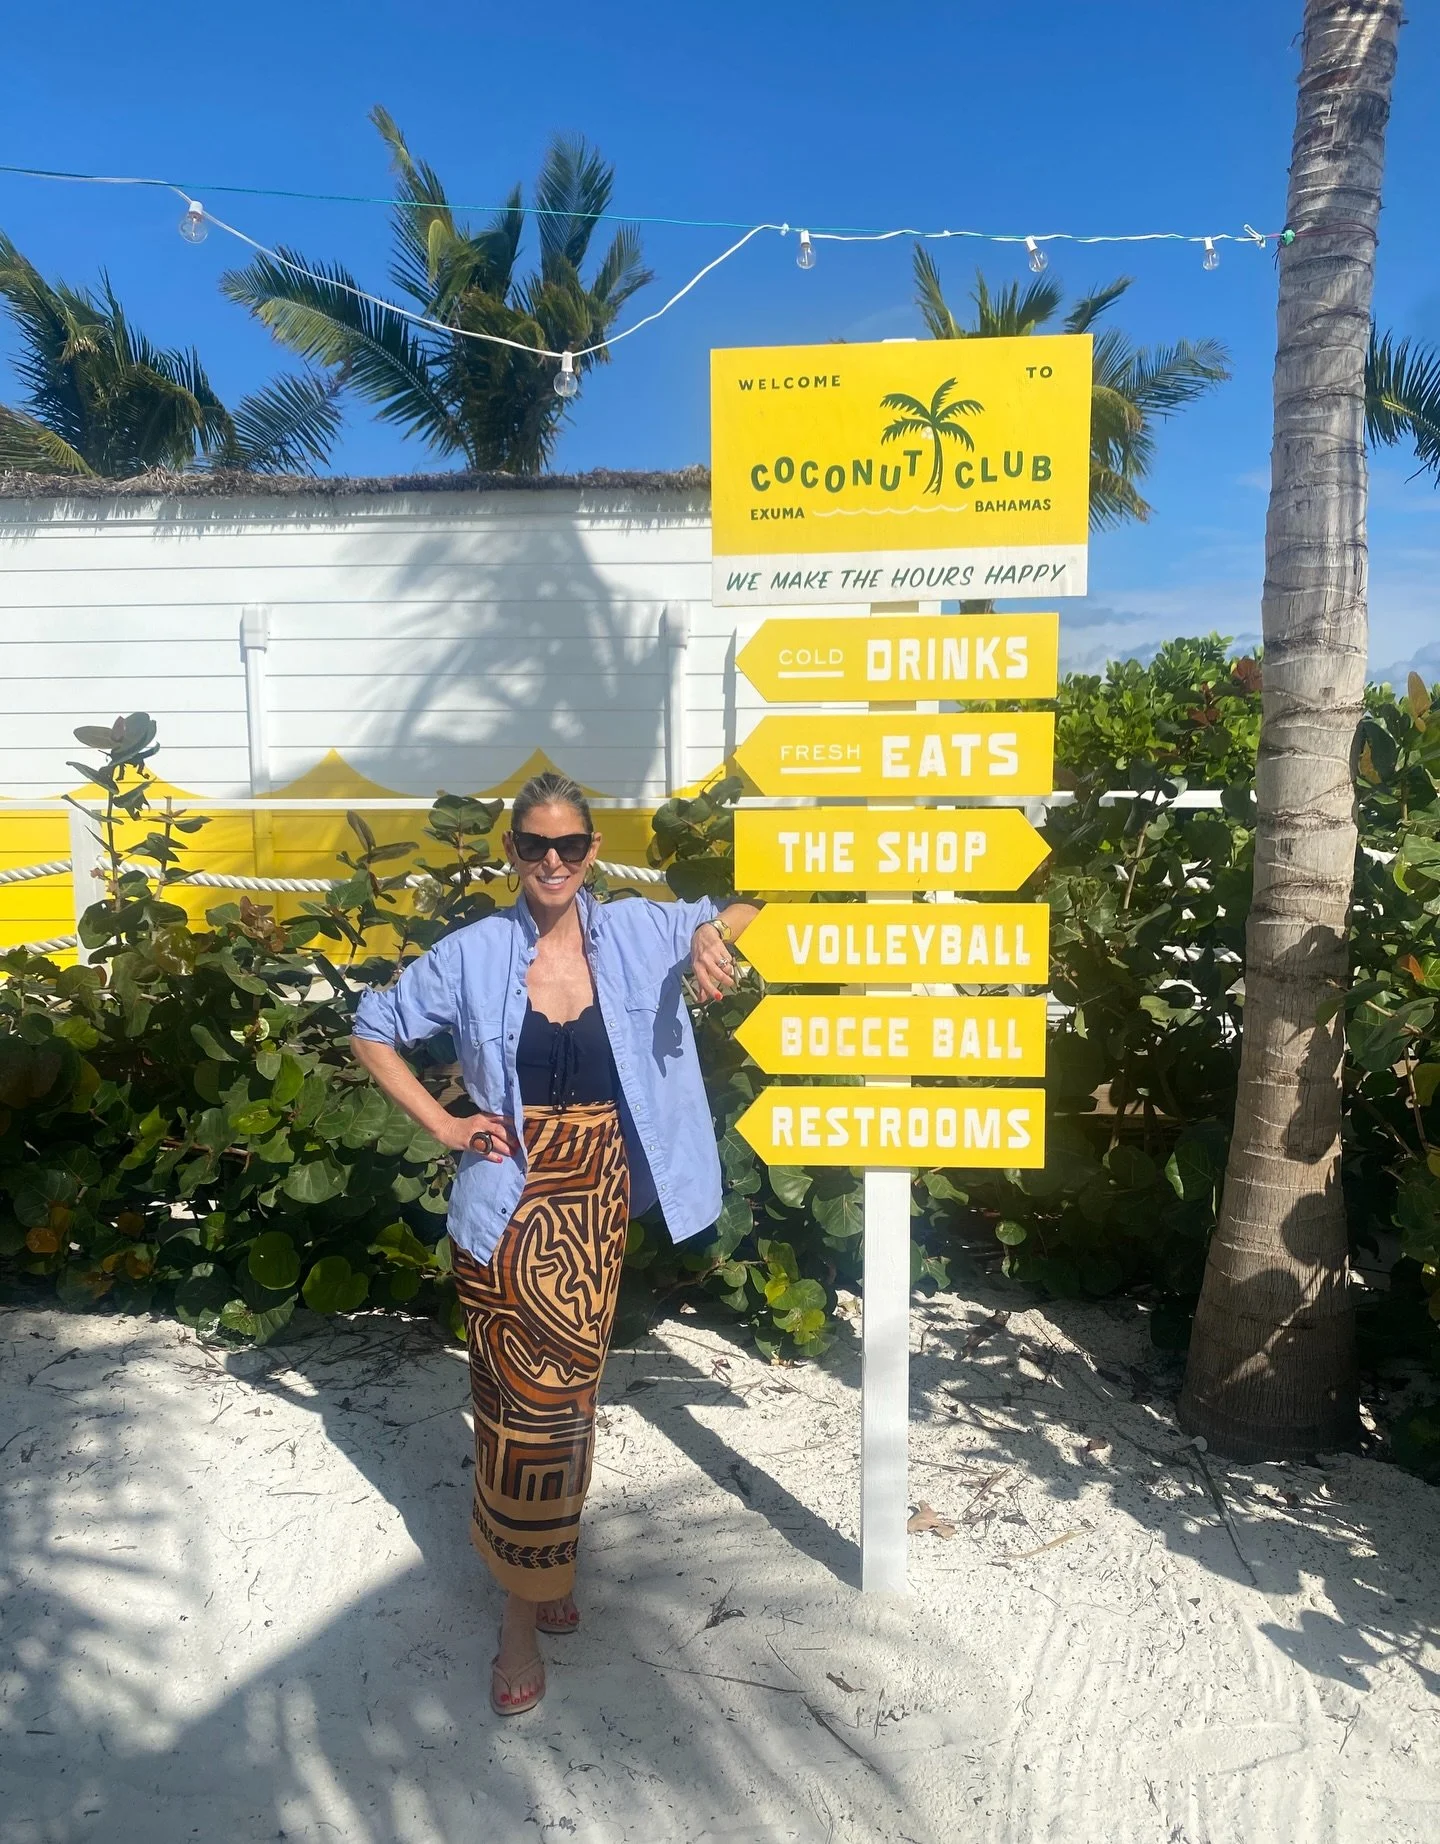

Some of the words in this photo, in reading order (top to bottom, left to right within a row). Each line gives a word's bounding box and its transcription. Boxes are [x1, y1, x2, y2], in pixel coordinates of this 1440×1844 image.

[738, 374, 842, 391] WELCOME
[1026, 366, 1053, 379] TO
[750, 450, 923, 493] COCONUT
[955, 451, 1053, 489] CLUB
[750, 507, 805, 521] EXUMA
[975, 498, 1052, 513] BAHAMAS
[726, 571, 761, 591] WE
[770, 569, 832, 590] MAKE
[841, 568, 884, 588] THE
[891, 566, 974, 588] HOURS
[984, 564, 1066, 584] HAPPY
[778, 648, 844, 665] COLD
[867, 636, 1029, 681] DRINKS
[780, 744, 861, 761] FRESH
[882, 733, 1018, 778] EATS
[778, 831, 854, 873] THE
[877, 831, 986, 873] SHOP
[786, 924, 1031, 965] VOLLEYBALL
[781, 1016, 909, 1057] BOCCE
[932, 1018, 1023, 1059] BALL
[772, 1106, 1031, 1149] RESTROOMS
